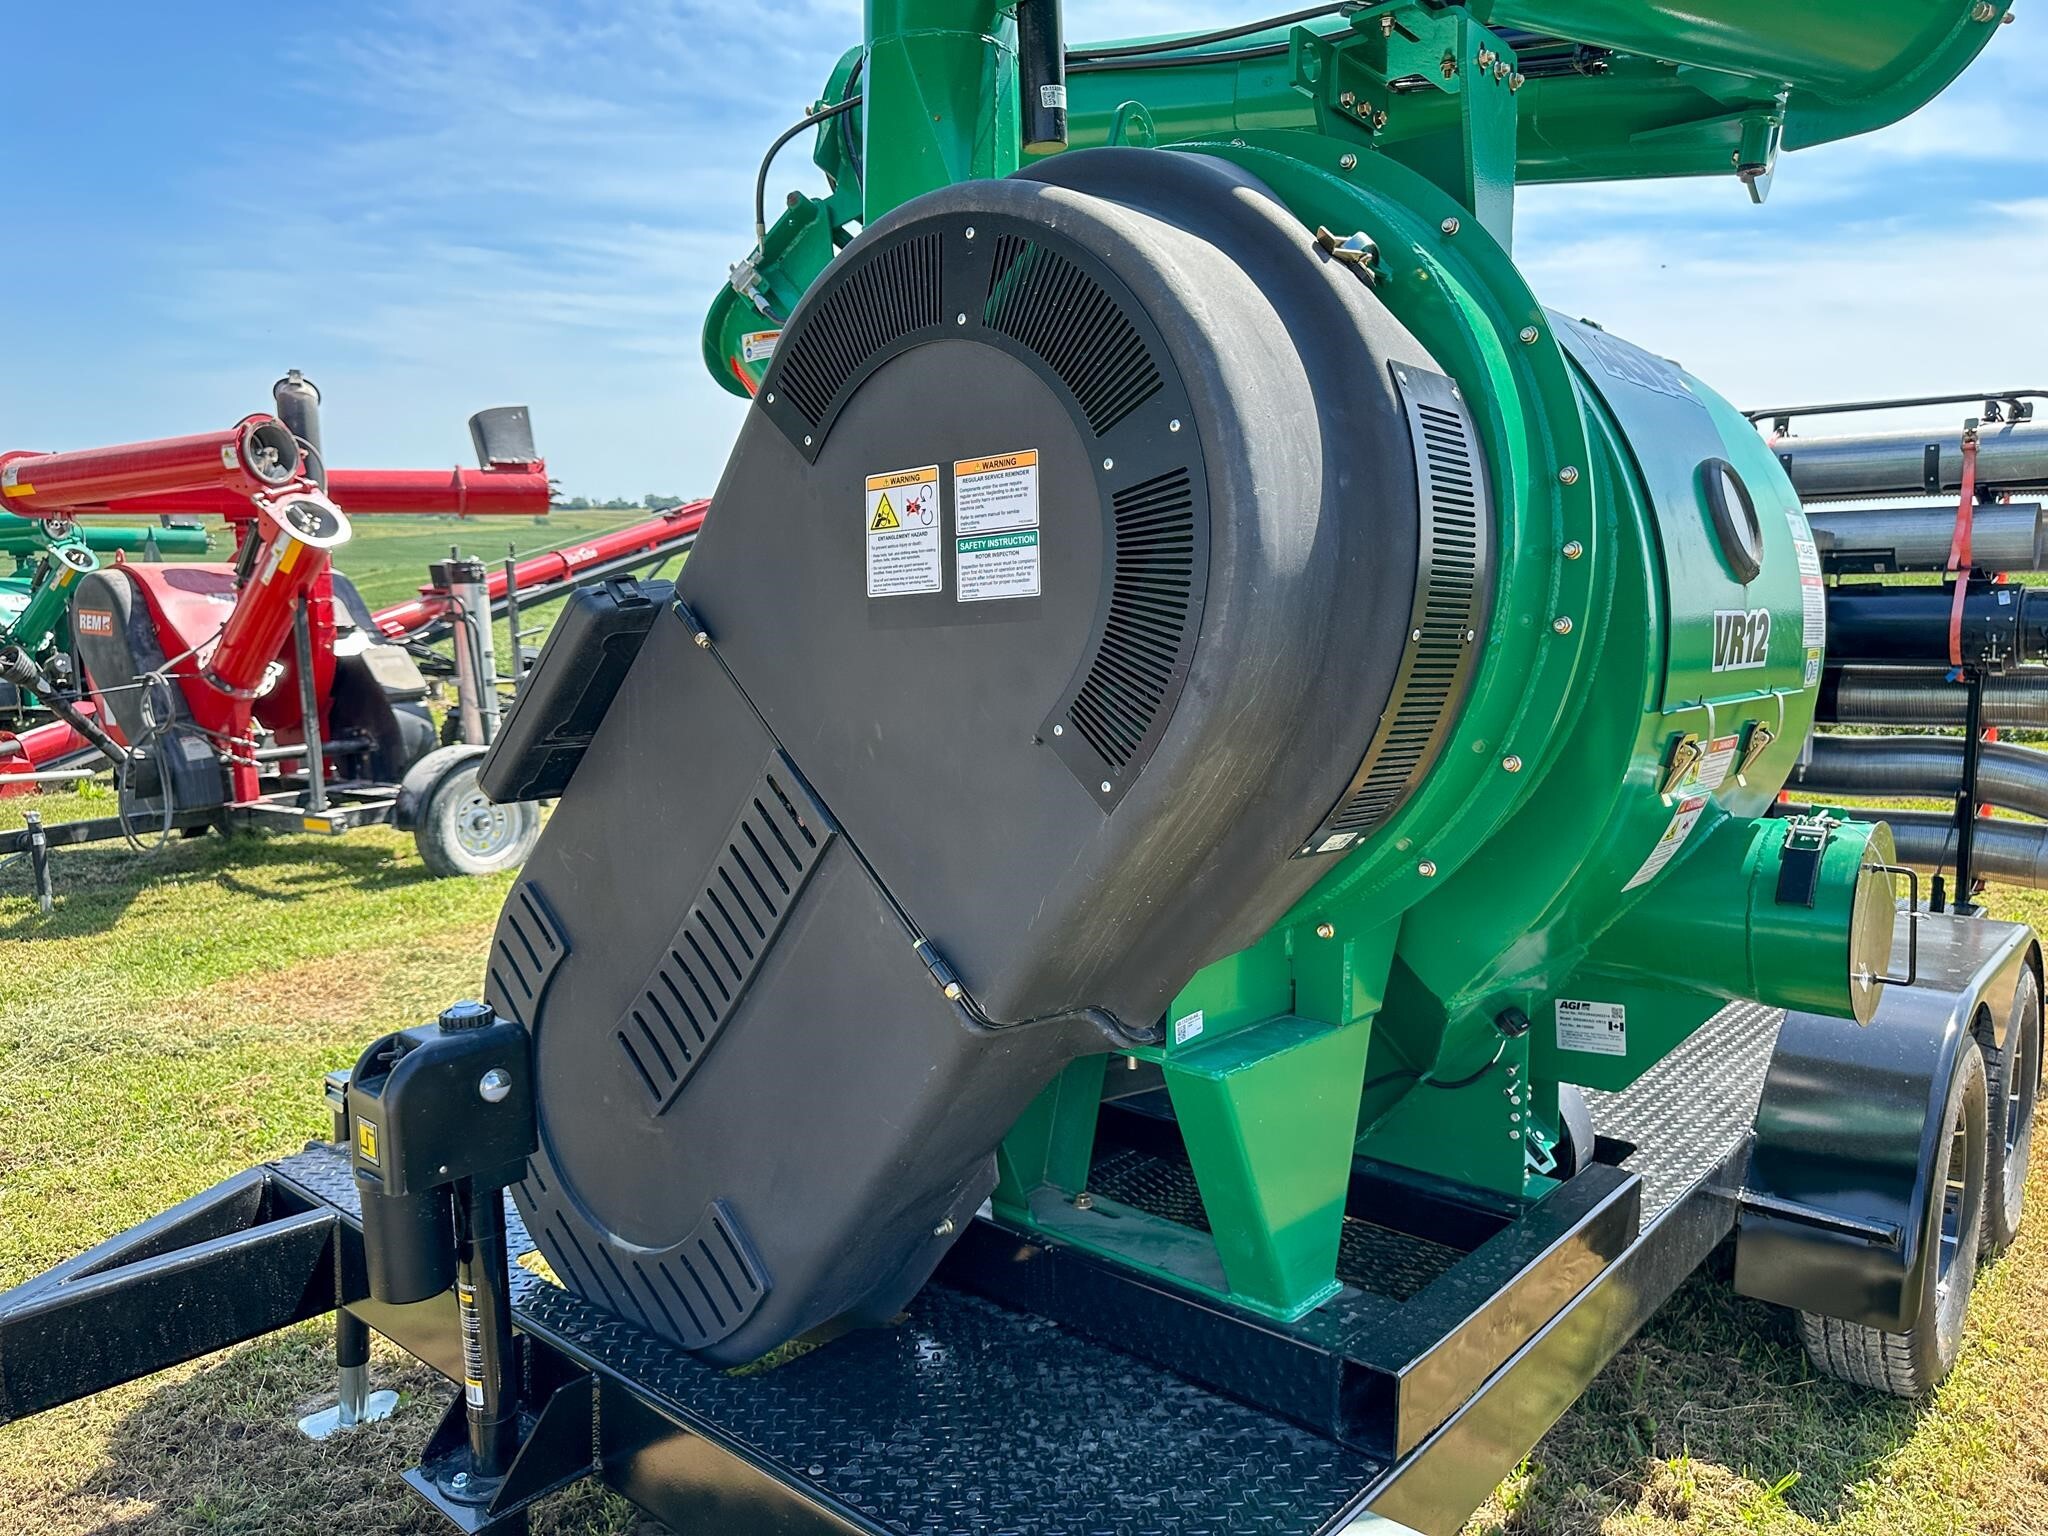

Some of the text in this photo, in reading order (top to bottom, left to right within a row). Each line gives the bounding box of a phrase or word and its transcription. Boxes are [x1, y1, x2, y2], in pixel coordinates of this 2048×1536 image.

[982, 458, 1016, 469] WARNING
[890, 474, 920, 485] WARNING
[960, 535, 1035, 550] SAFETY INSTRUCTION
[1714, 613, 1769, 666] VR12
[1560, 1001, 1580, 1010] AGI
